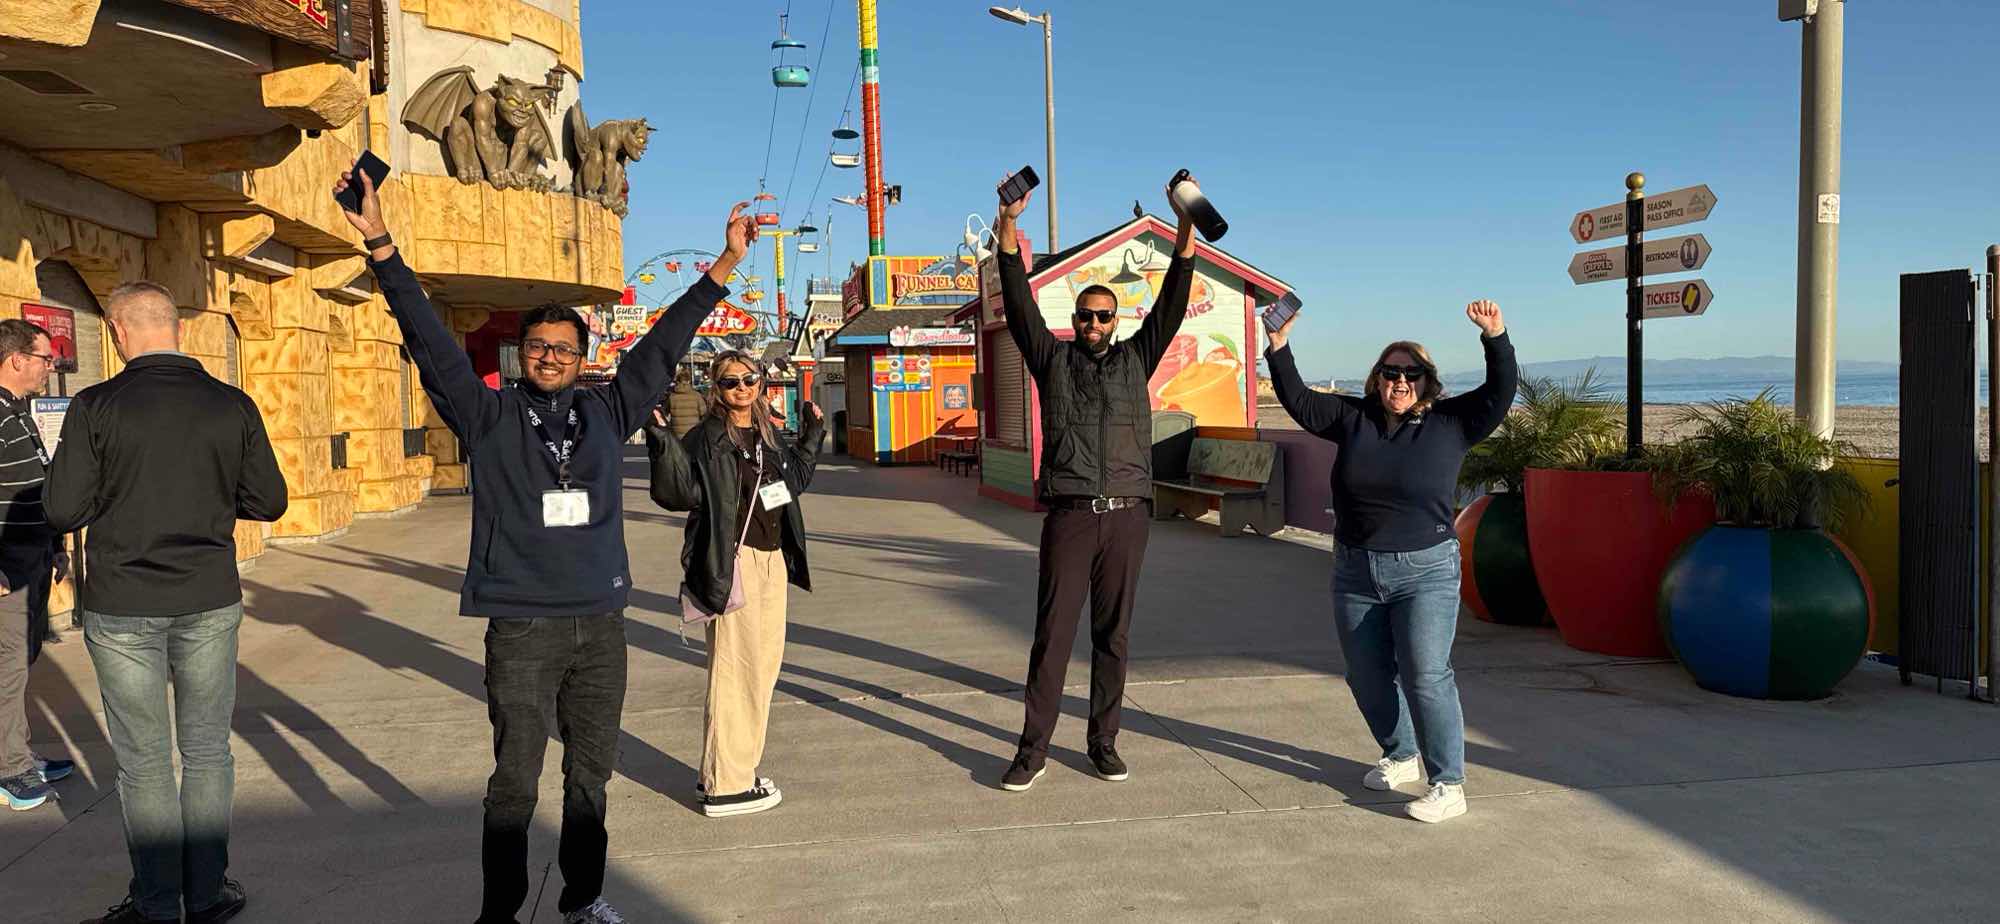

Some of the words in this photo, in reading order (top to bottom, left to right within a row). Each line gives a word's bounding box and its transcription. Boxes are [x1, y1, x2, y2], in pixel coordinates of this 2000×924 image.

[1647, 199, 1672, 211] SEASON
[1600, 214, 1613, 224] FIRST
[1647, 212, 1662, 221] PASS
[1663, 208, 1684, 219] OFFICE
[1646, 250, 1679, 262] RESTROOMS
[895, 274, 954, 297] FUNNEL
[1646, 292, 1680, 305] TICKETS
[616, 307, 643, 315] GUEST
